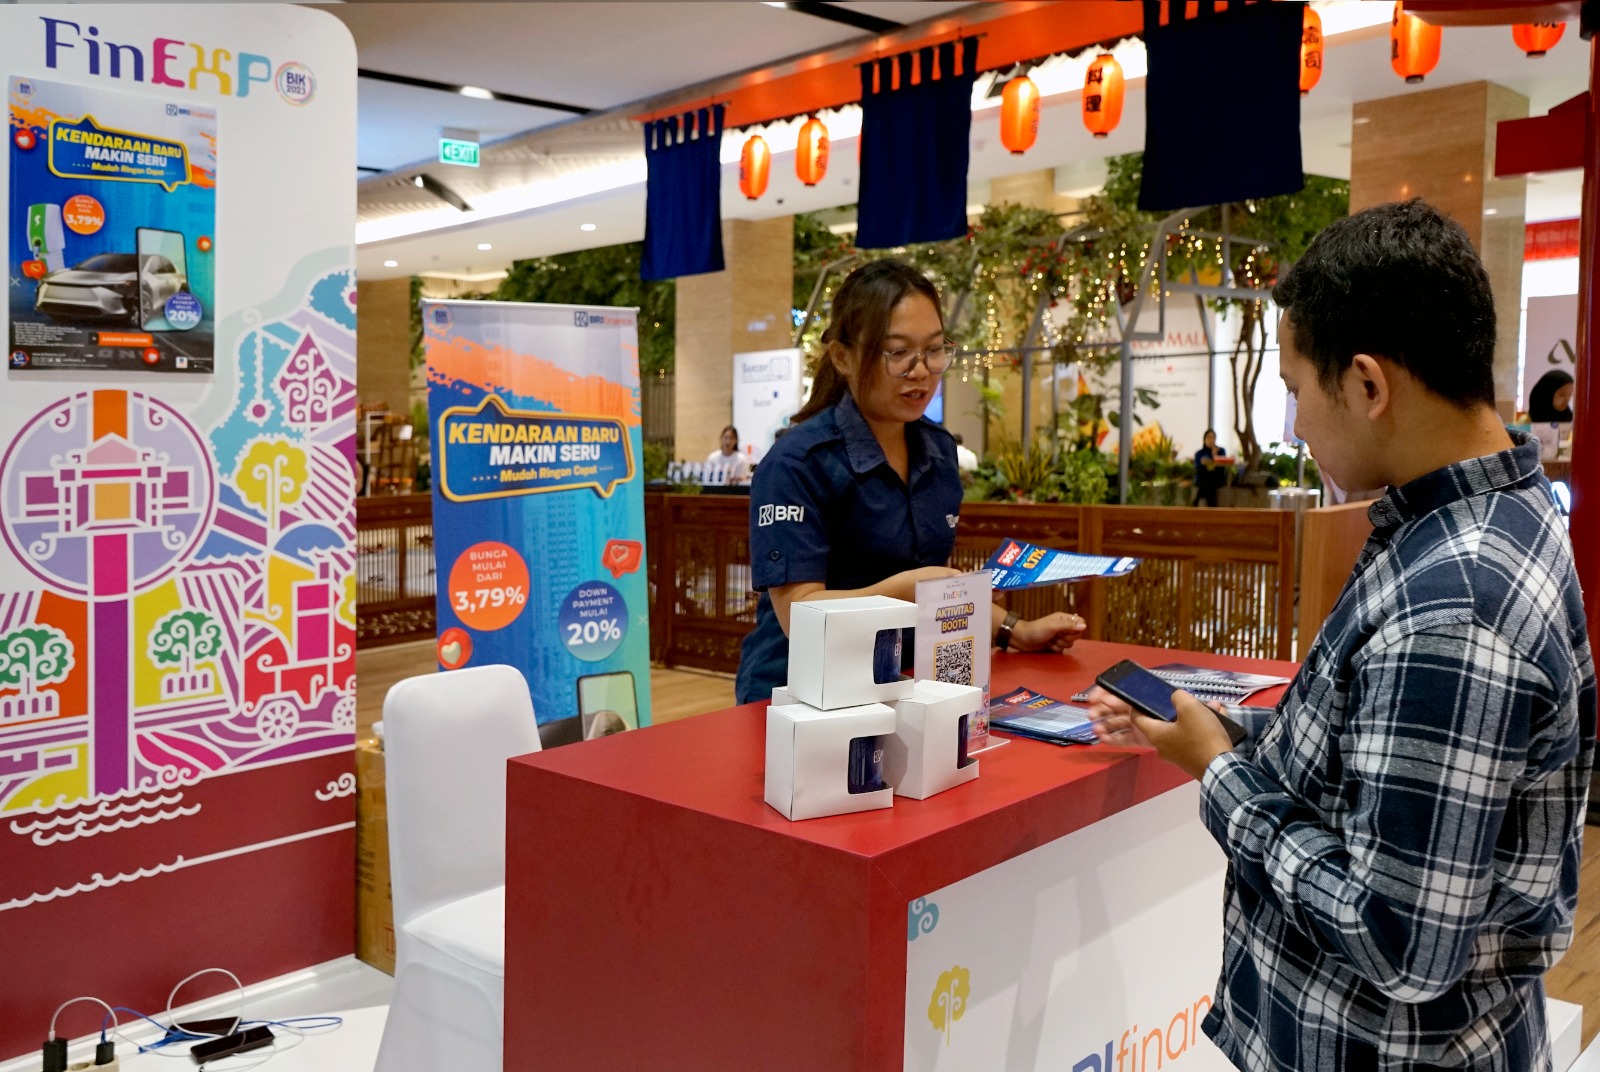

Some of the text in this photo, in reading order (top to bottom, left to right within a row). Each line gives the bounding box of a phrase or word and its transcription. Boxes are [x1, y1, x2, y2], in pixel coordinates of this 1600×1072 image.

[286, 71, 306, 86] BIK
[56, 127, 182, 158] KENDARAAN BARU
[85, 146, 167, 168] MAKIN SERU
[451, 144, 475, 162] EXIT
[66, 213, 103, 227] 3,79%
[169, 309, 200, 322] 20%
[448, 422, 619, 444] KENDARAAN BARU
[489, 444, 601, 466] MAKIN SERU
[500, 468, 537, 482] Mudah
[539, 466, 572, 480] Ringan
[775, 505, 804, 522] BRI
[469, 549, 508, 561] BUNGA
[472, 560, 506, 571] MULAI
[476, 571, 503, 583] DARI
[455, 585, 526, 614] 3,79%
[579, 588, 608, 598] DOWN
[572, 596, 614, 608] PAYMENT
[579, 607, 608, 618] MULAI
[935, 602, 974, 621] AKTIVITAS
[567, 617, 622, 646] 20%
[941, 616, 968, 634] BOOTH
